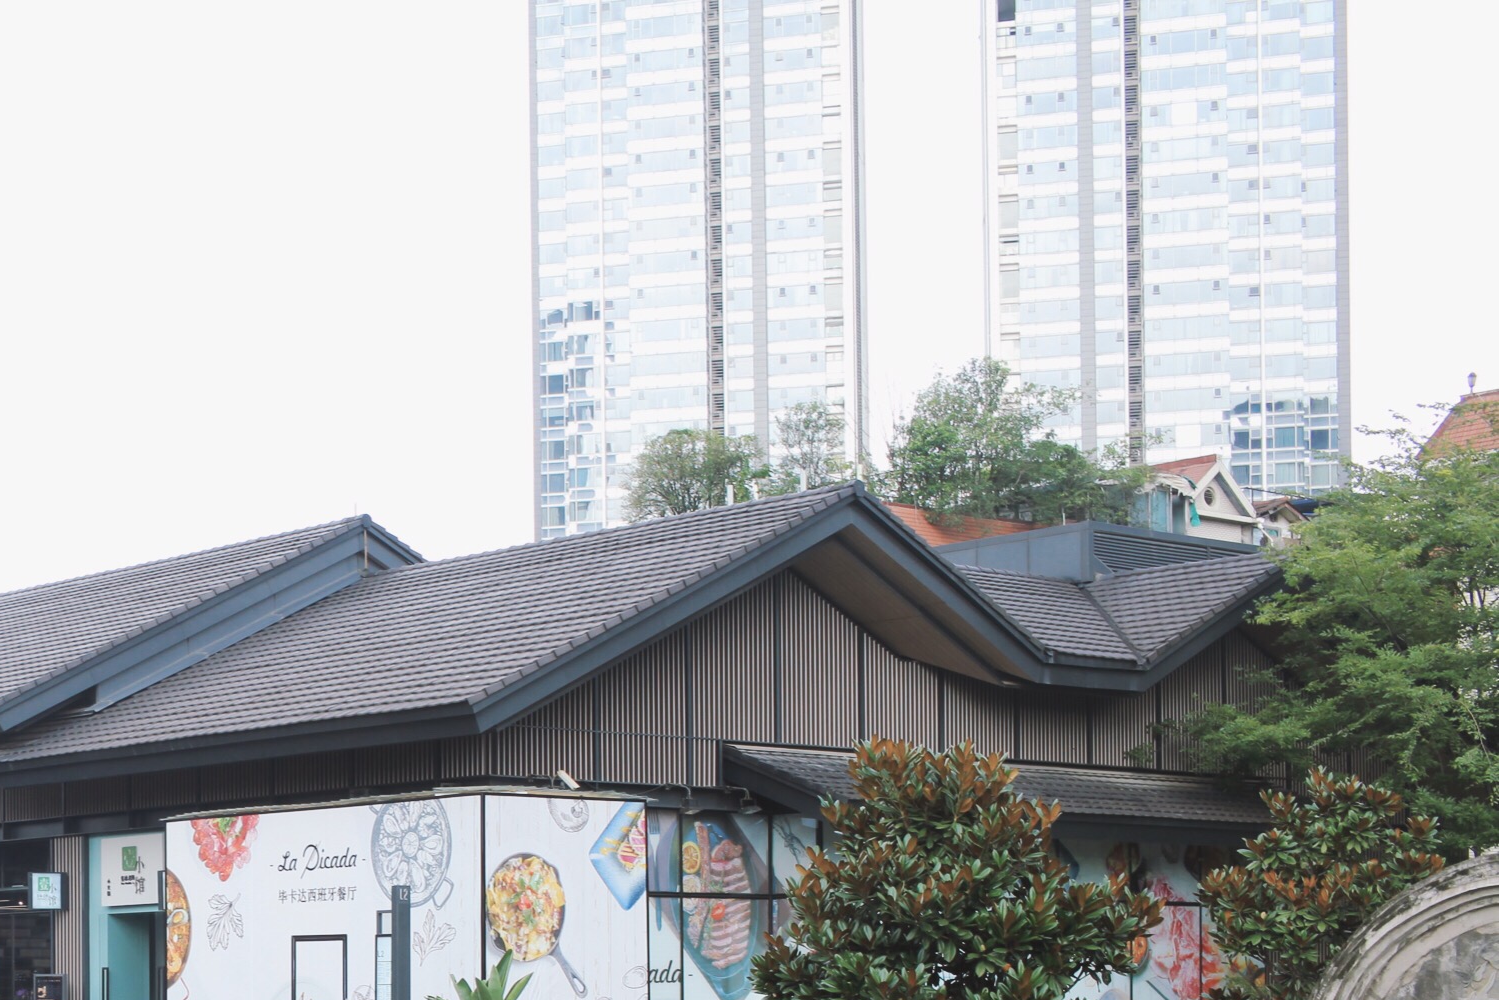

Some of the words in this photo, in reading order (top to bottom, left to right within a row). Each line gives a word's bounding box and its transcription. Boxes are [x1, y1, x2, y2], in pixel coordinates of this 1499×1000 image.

[278, 851, 298, 871] La
[278, 886, 358, 904] 毕卡达西班牙餐厅
[399, 888, 409, 901] L2
